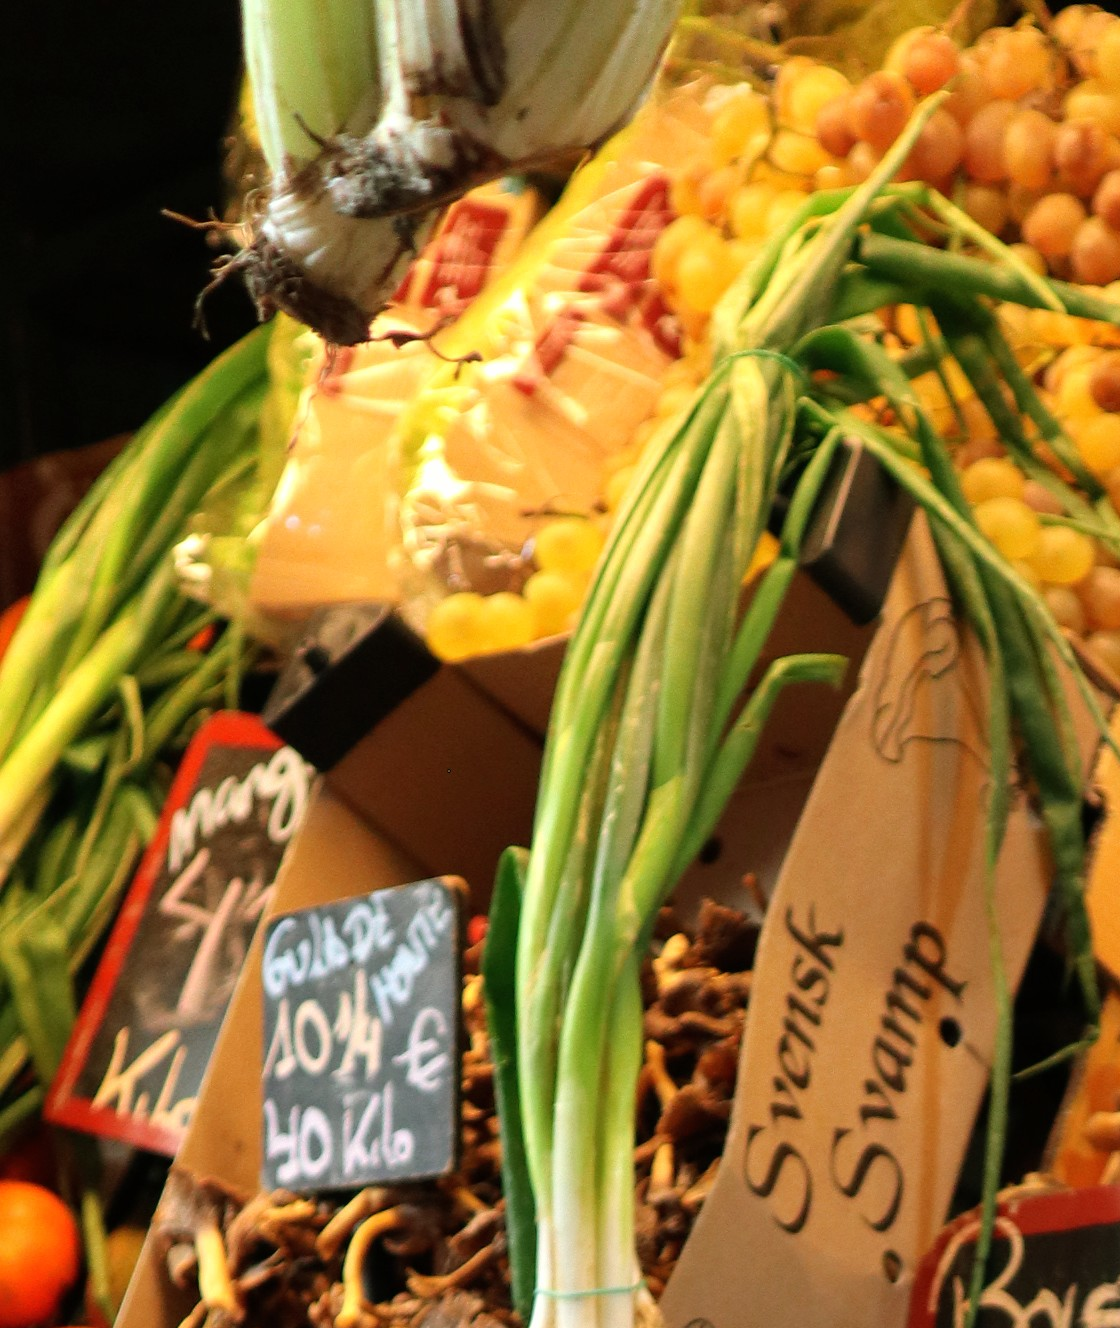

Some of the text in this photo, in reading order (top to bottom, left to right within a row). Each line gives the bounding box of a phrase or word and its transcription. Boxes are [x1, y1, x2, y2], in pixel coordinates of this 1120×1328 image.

[261, 997, 331, 1081] 10
[744, 903, 844, 1233] Svensk
[830, 920, 969, 1232] Svamp
[263, 1098, 333, 1184] 40
